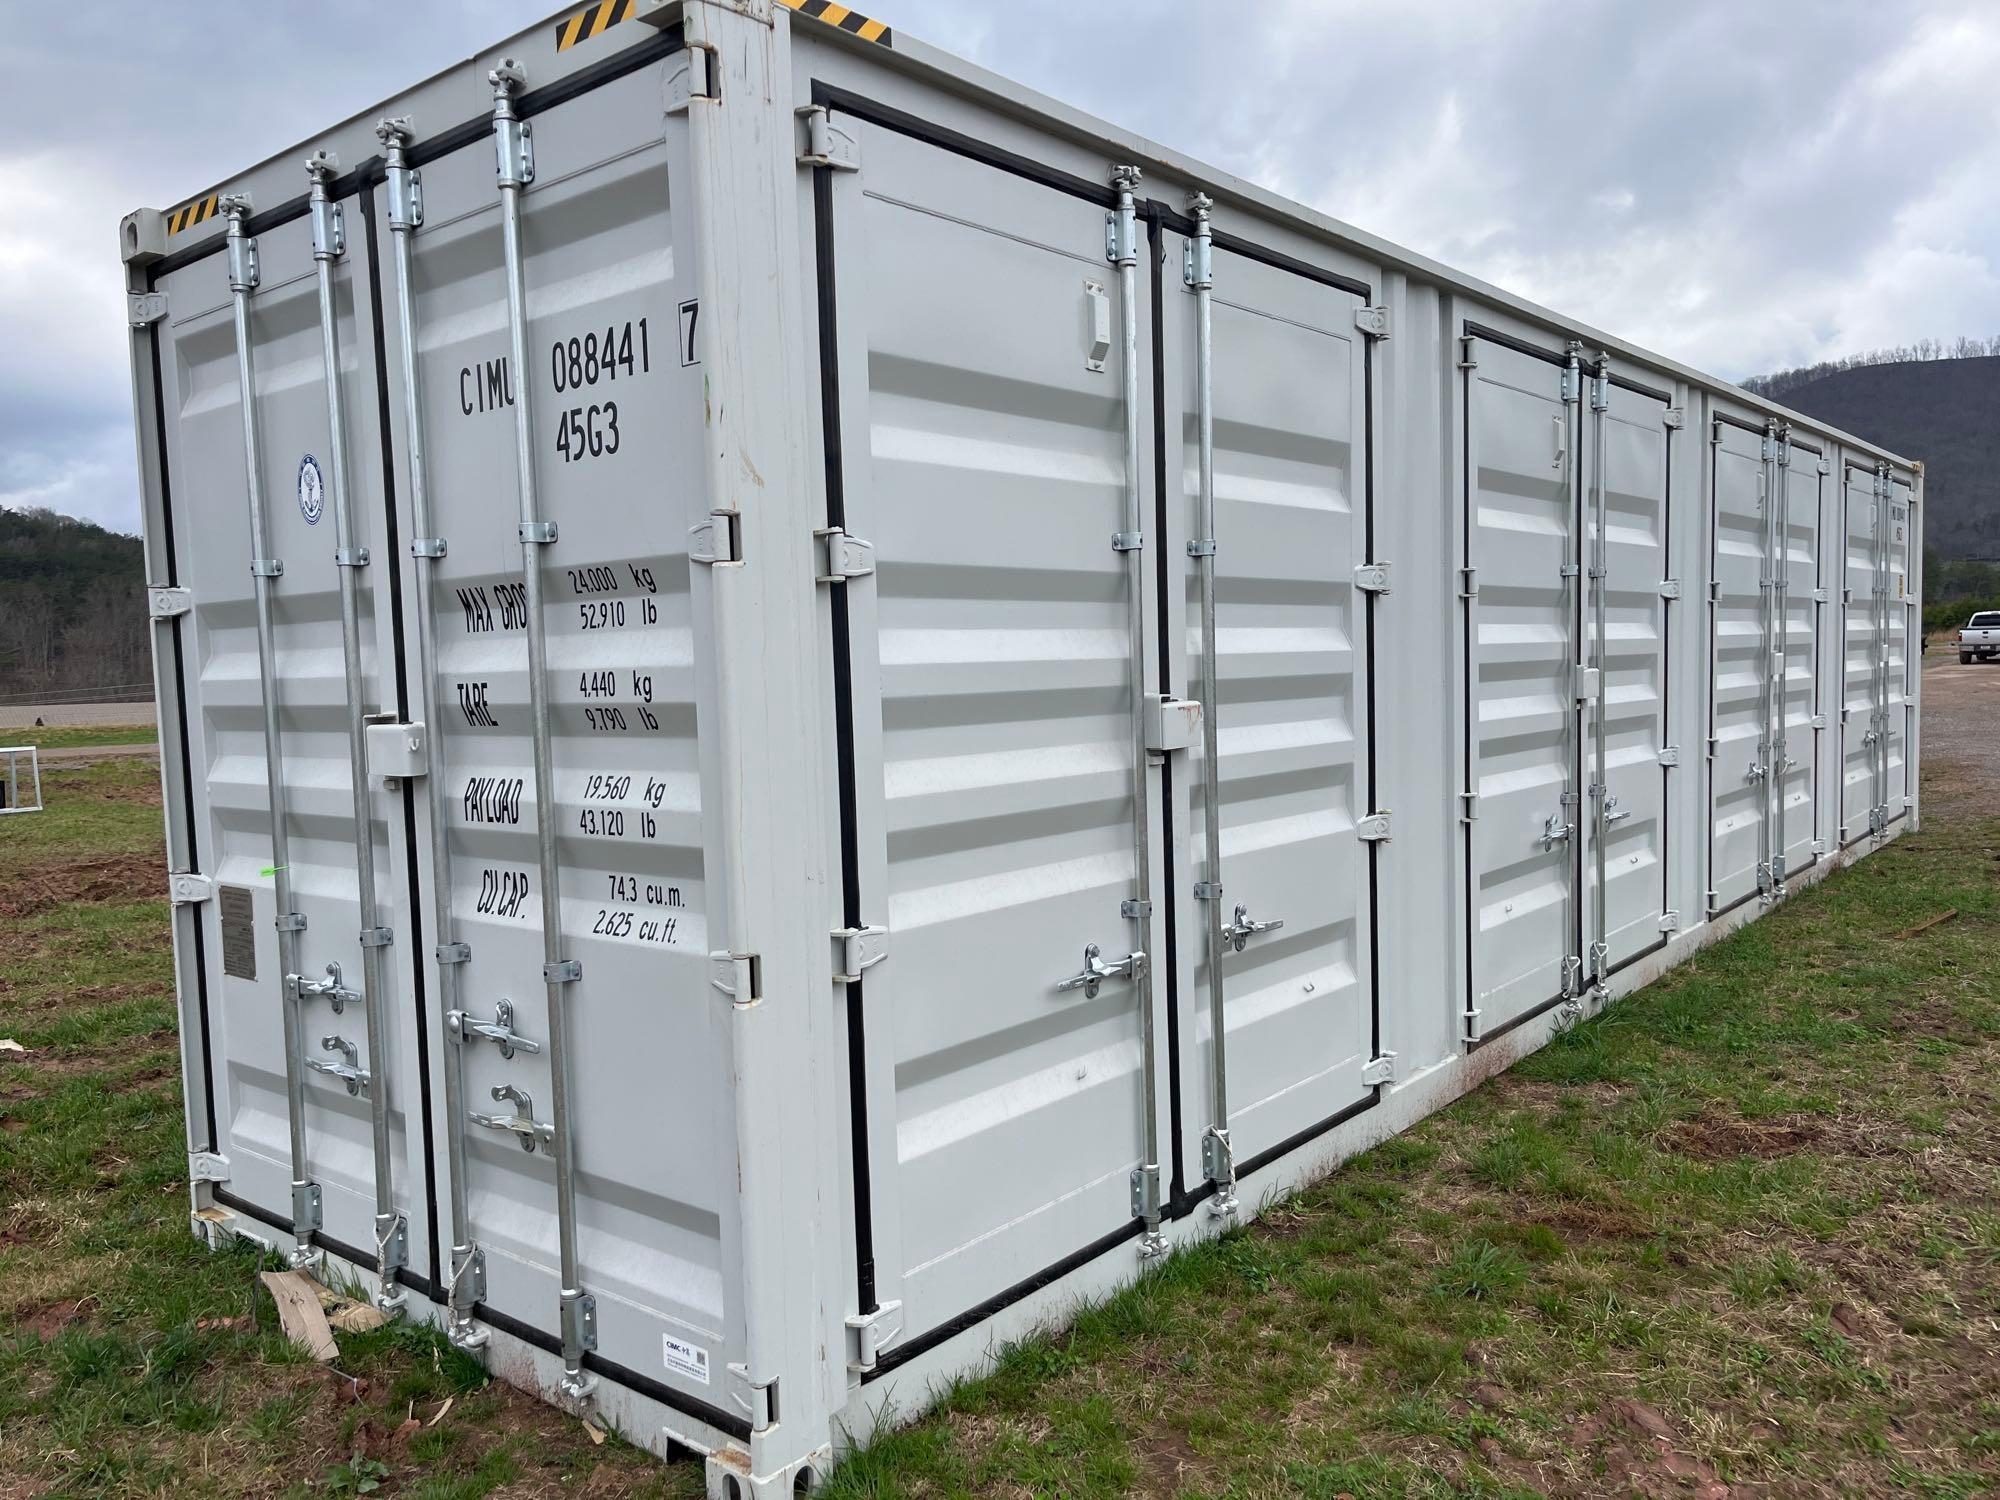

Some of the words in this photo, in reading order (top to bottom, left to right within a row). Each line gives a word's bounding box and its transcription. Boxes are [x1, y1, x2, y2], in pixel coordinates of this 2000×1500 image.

[552, 317, 649, 393] 088441
[682, 303, 699, 362] 7
[556, 401, 620, 462] 45G3
[456, 586, 494, 633] MAX
[493, 583, 527, 630] GRO
[628, 563, 657, 594] kg
[642, 598, 657, 625] lb
[457, 682, 499, 727] TARE
[633, 669, 652, 703] kg
[637, 706, 659, 731] lb
[464, 777, 523, 825] PAYLOAD
[643, 776, 666, 809] kg
[641, 812, 656, 839] lb
[608, 874, 638, 902] 74.3
[646, 884, 685, 908] cu.m.
[639, 918, 677, 944] cu.ft.
